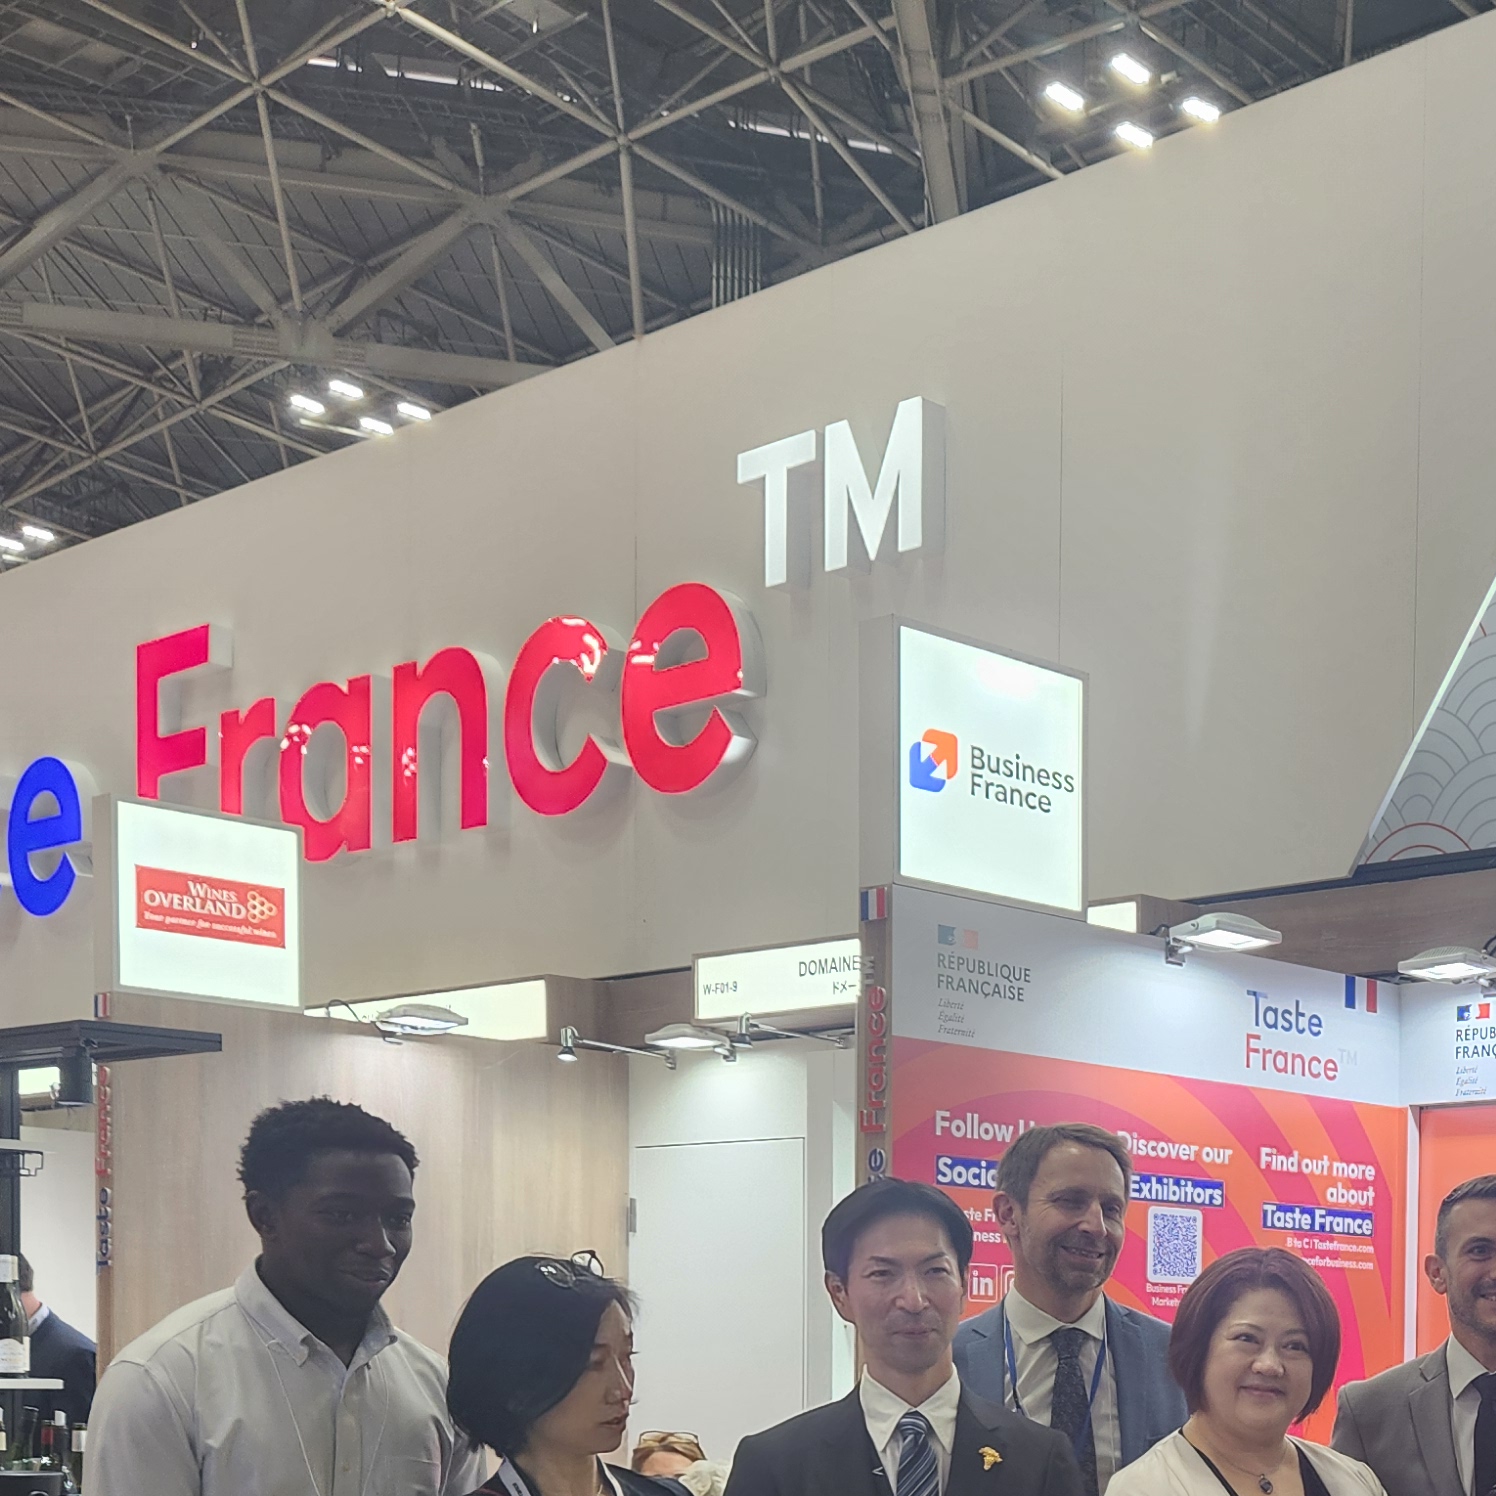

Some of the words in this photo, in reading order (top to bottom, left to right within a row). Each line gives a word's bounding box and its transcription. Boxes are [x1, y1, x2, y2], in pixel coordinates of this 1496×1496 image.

[737, 396, 922, 586] TM
[137, 582, 742, 861] France
[970, 745, 1074, 793] Business
[970, 773, 1051, 813] France
[144, 890, 246, 919] OVERLAND
[937, 951, 1031, 983] RÉPUBLIQUE
[703, 982, 737, 995] W-F01-9
[937, 973, 1025, 1001] FRANÇAISE
[1246, 989, 1323, 1037] Taste
[860, 986, 886, 1133] France
[1245, 1033, 1338, 1081] France
[935, 1110, 1013, 1142] Follow
[1202, 1146, 1233, 1164] our
[1260, 1147, 1298, 1172] Find
[1302, 1156, 1329, 1175] out
[1333, 1161, 1375, 1181] more
[1130, 1175, 1223, 1206] Exhibitors
[1326, 1182, 1374, 1206] about
[1263, 1205, 1311, 1231] Taste
[1315, 1210, 1372, 1235] France
